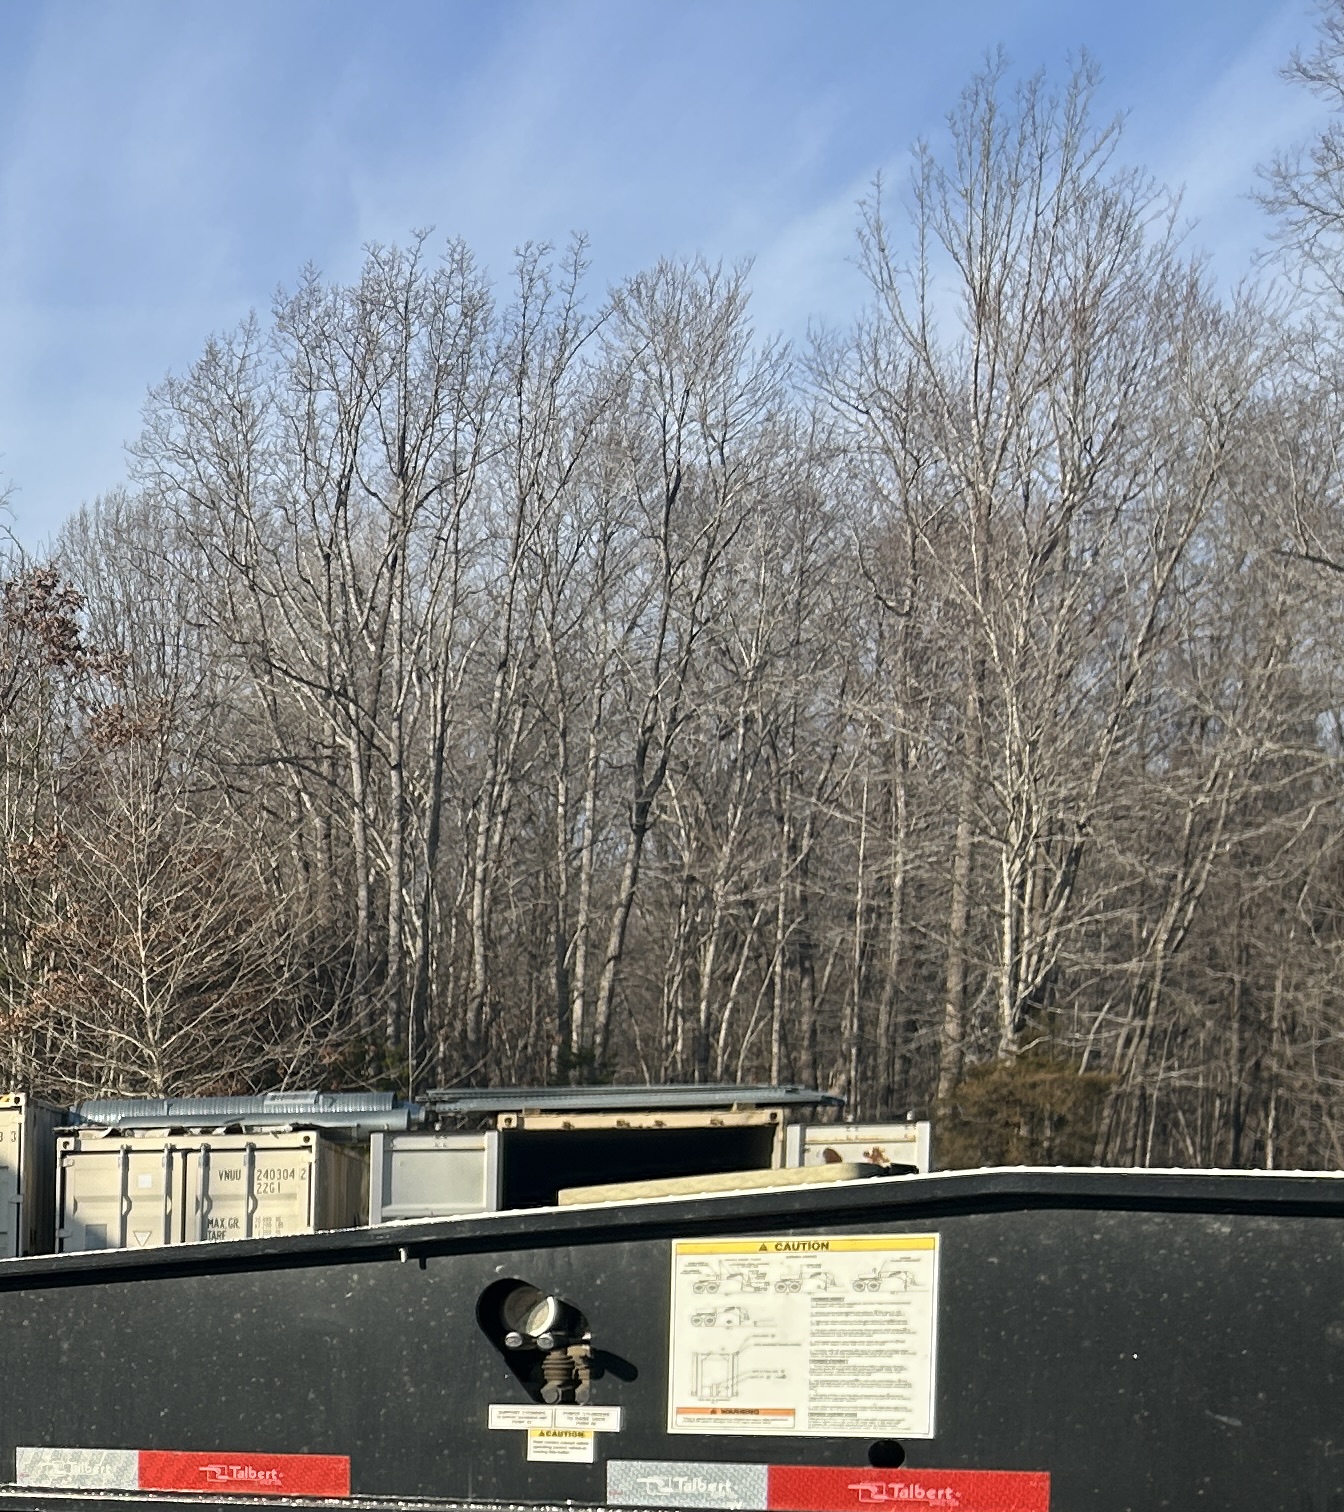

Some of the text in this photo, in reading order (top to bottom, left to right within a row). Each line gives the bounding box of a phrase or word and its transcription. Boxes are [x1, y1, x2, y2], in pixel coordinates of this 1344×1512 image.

[10, 1130, 17, 1143] 3
[218, 1168, 307, 1181] VNUU 240304 2
[256, 1182, 281, 1194] 22G1
[774, 1241, 830, 1252] CAUTION
[545, 1430, 585, 1438] CAUTION
[230, 1464, 278, 1480] Talbert
[673, 1476, 732, 1495] Talbert
[888, 1482, 954, 1500] Talbert
